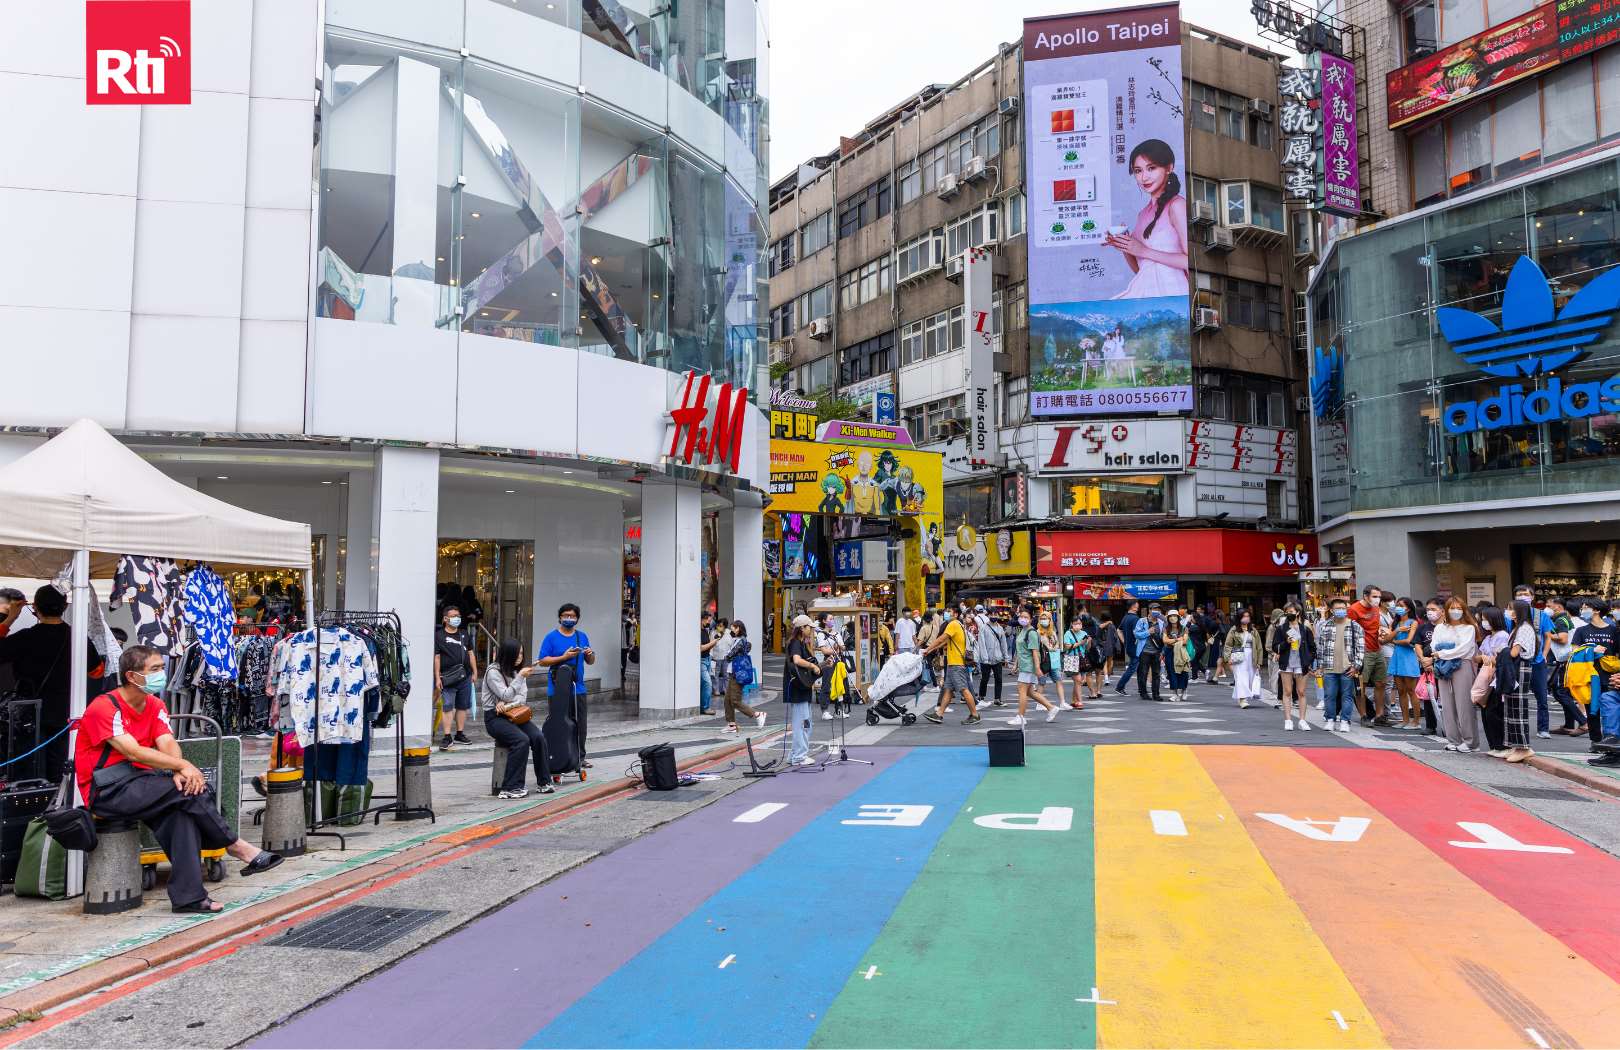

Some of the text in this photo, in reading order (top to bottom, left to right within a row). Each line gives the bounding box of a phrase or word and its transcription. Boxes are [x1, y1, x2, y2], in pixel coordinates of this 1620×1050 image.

[1034, 19, 1170, 51] Apollo Taipei
[769, 386, 817, 409] Welcome
[1035, 390, 1188, 409] 訂購電話 0800556677
[1444, 377, 1620, 434] adidas
[669, 368, 748, 475] H&M
[770, 410, 818, 440] 門町
[976, 387, 989, 451] hair salon
[840, 424, 897, 440] Xi-Men Walker
[789, 454, 805, 462] MAN
[1104, 451, 1180, 466] hair salon
[795, 472, 817, 481] MAN
[1272, 543, 1309, 567] J&G
